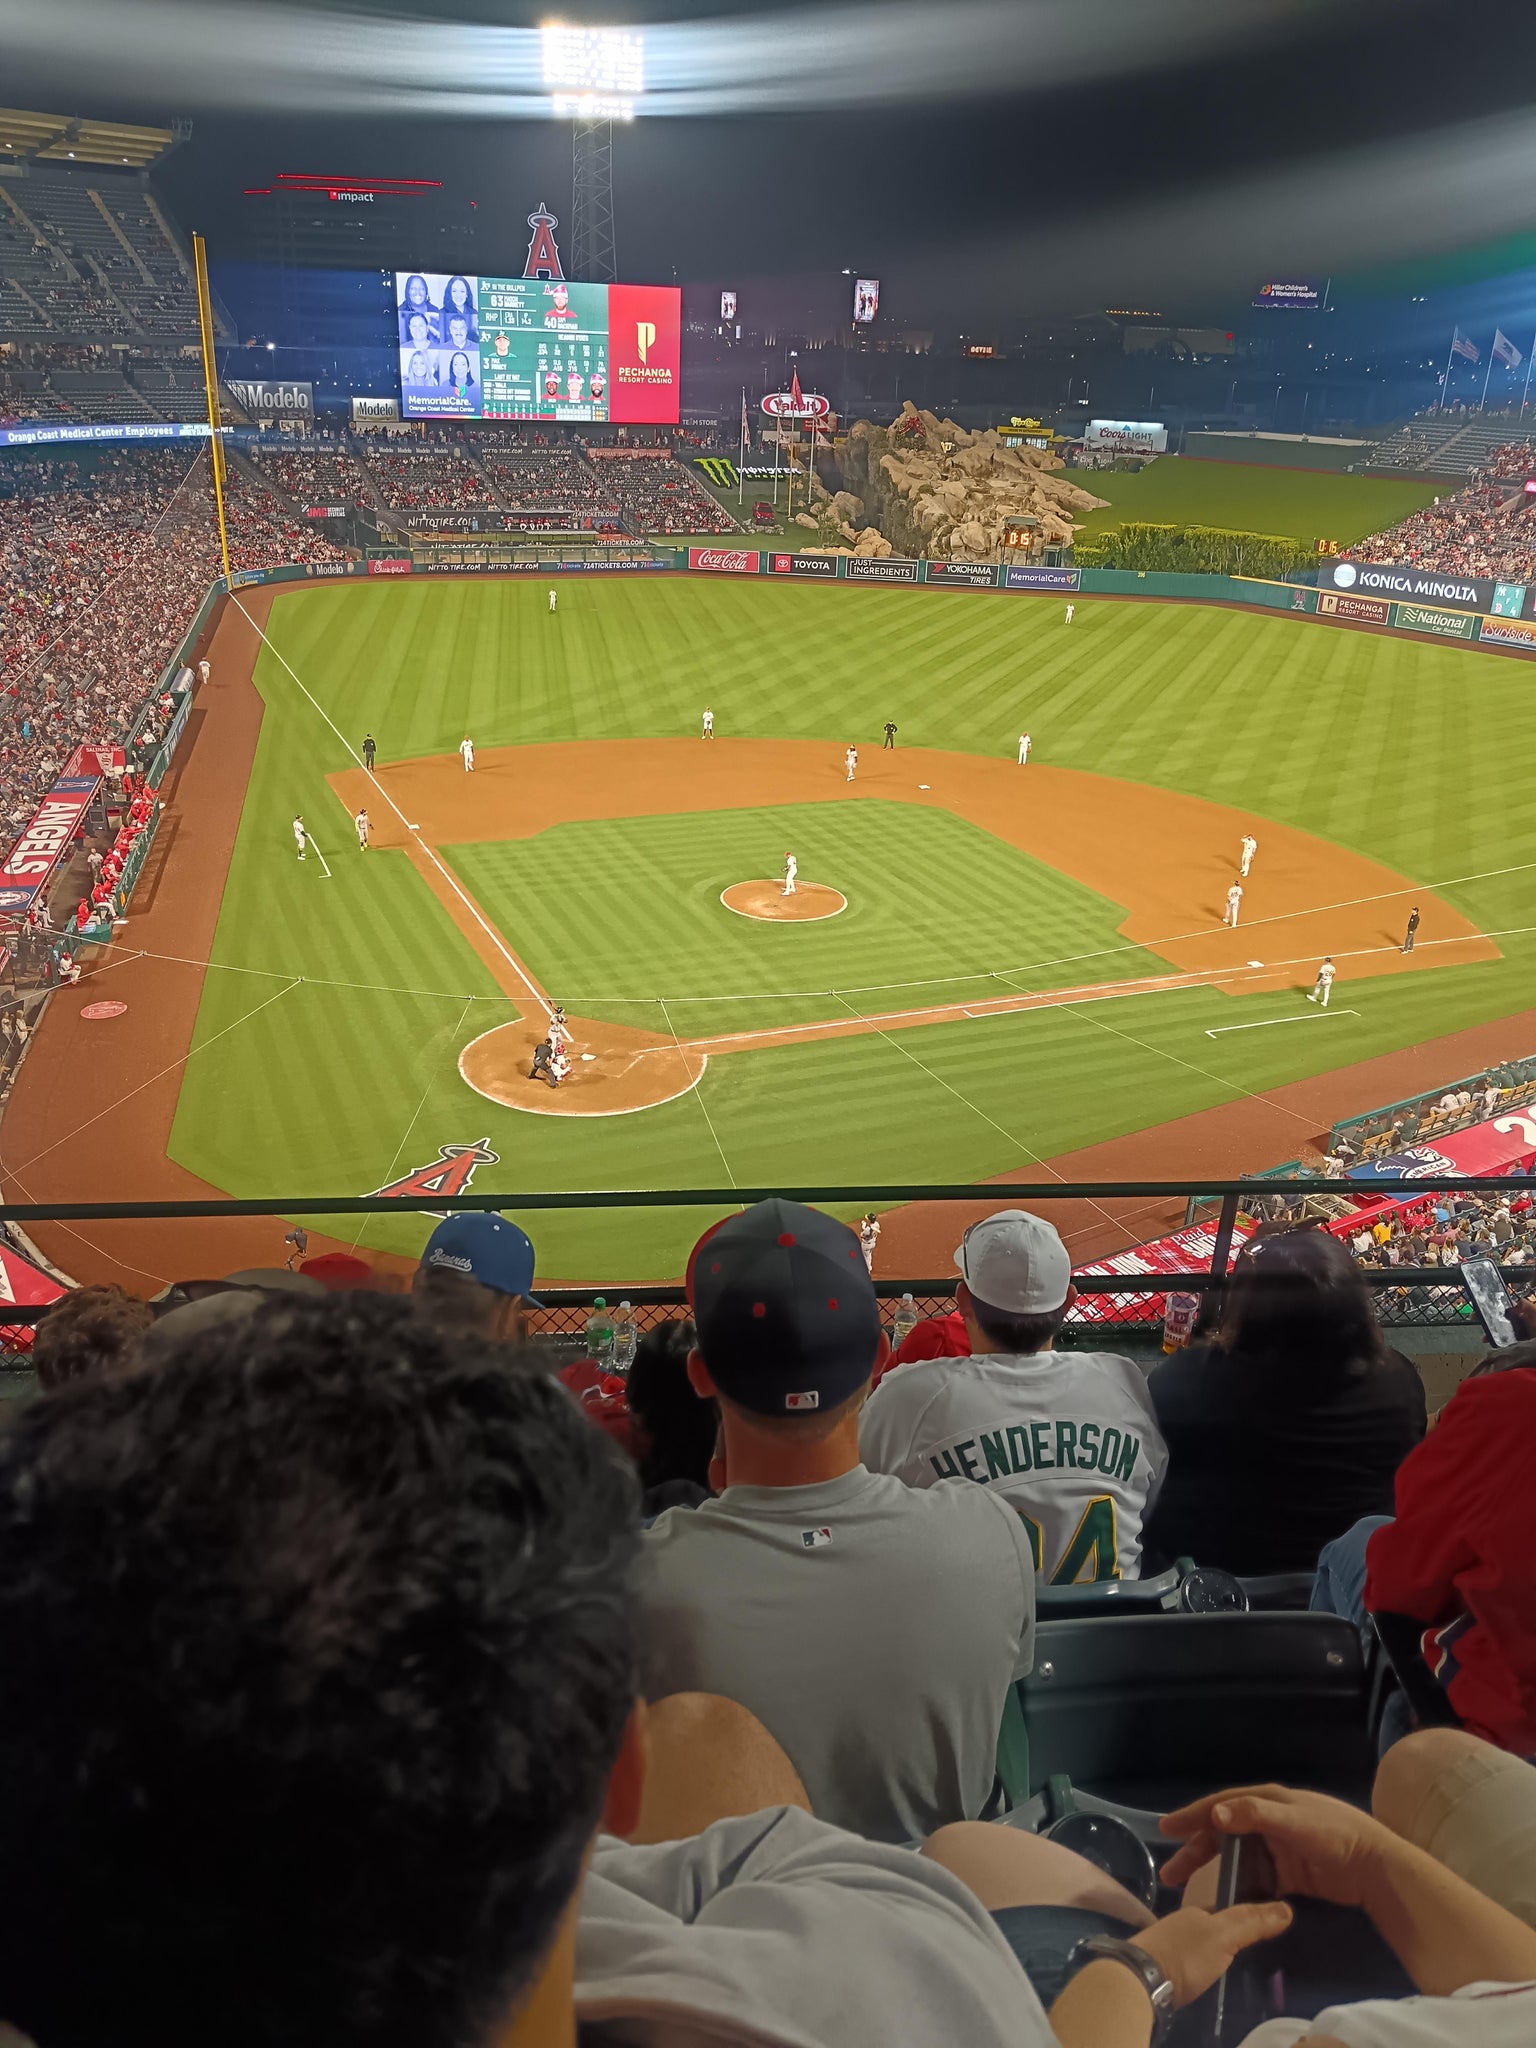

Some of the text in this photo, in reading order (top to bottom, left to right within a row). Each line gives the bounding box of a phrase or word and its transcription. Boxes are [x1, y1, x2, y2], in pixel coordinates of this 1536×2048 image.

[337, 191, 374, 203] impact
[544, 317, 557, 329] 40
[618, 367, 672, 378] PECHANGA
[247, 385, 309, 409] Modelo
[358, 402, 393, 416] Modelo
[8, 432, 36, 444] Orange
[37, 430, 58, 440] Coast
[60, 428, 89, 439] Medical
[90, 427, 124, 438] Center
[125, 426, 174, 438] Employees
[1099, 427, 1153, 440] Coors LIGHT
[1009, 532, 1030, 546] 0:15
[1319, 539, 1338, 553] 0:16
[450, 563, 481, 571] TIRE.COM
[698, 550, 750, 570] Coca-Cola
[793, 560, 830, 570] TOYOTA
[316, 564, 343, 575] Modelo
[853, 566, 910, 577] INGREDIENTS
[946, 566, 992, 575] YOKOHAMA
[969, 576, 991, 585] TIRES
[1010, 572, 1066, 583] MemorialCare
[1359, 571, 1478, 603] KONICA MINOLTA
[1338, 607, 1384, 619] RESORT CASINO
[1339, 600, 1384, 614] PECHANGA
[1416, 610, 1467, 629] National
[1442, 626, 1463, 635] Rental
[1485, 622, 1532, 642] Surfside
[3, 801, 82, 875] ANGELS
[1170, 1227, 1207, 1246] Plaid
[429, 1248, 472, 1269] Bananas
[929, 1420, 1141, 1485] HENDERSON
[1017, 1494, 1123, 1585] 4
